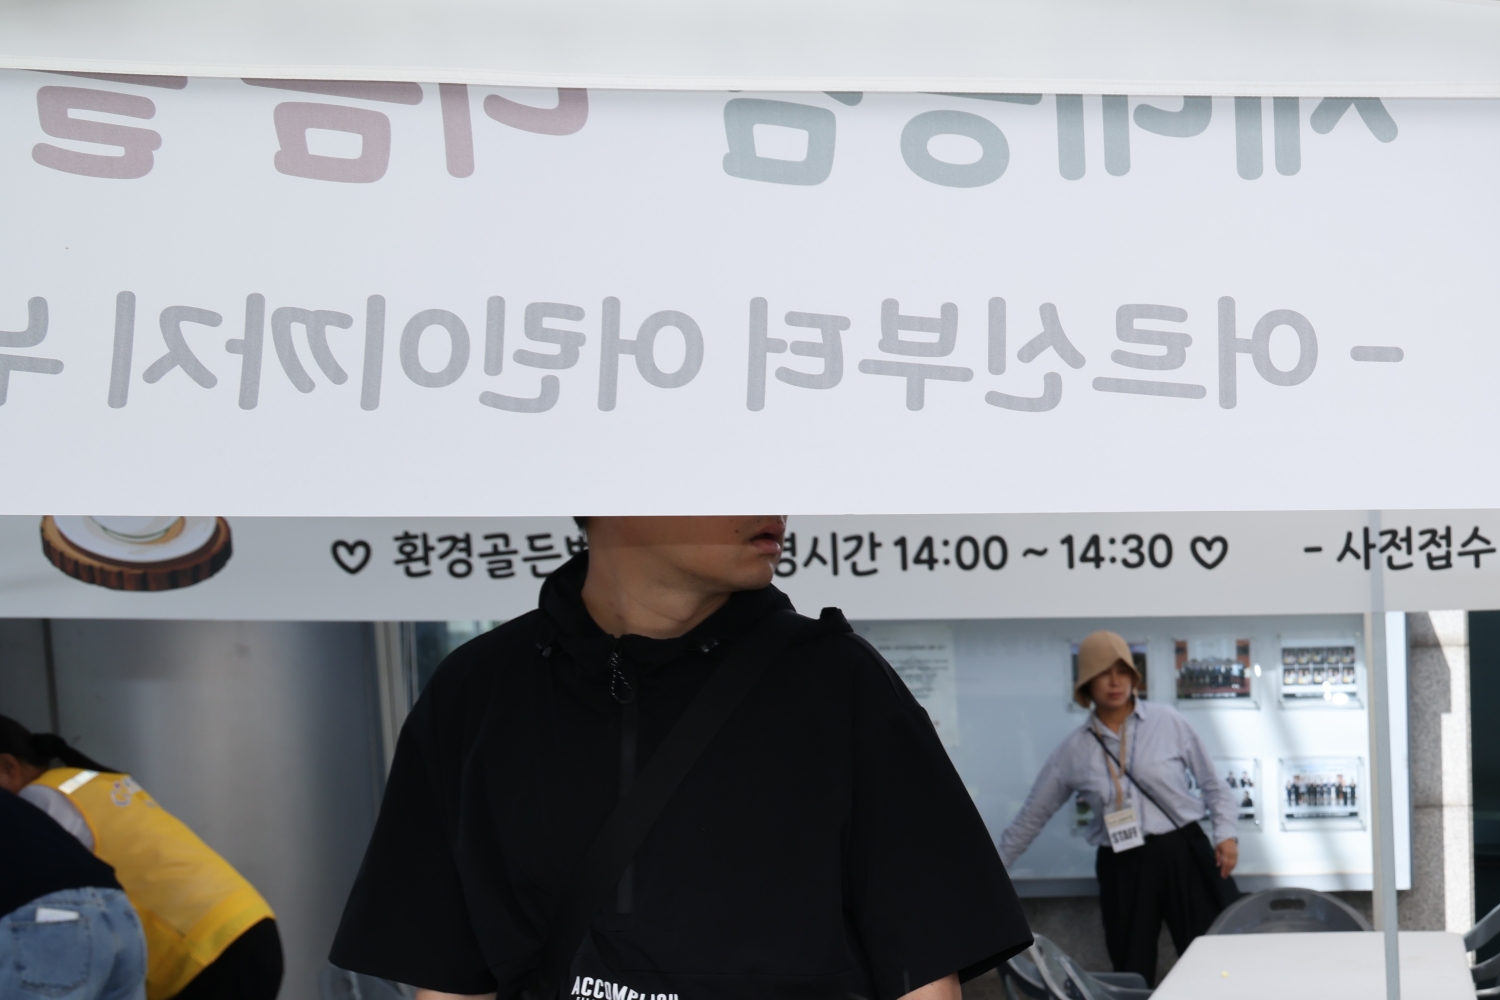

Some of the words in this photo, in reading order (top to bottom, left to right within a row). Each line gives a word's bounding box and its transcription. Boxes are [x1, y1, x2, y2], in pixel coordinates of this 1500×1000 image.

[893, 534, 1008, 571] 14:00
[1060, 533, 1173, 570] 14:30
[1335, 525, 1497, 571] 사전접수
[1111, 826, 1138, 844] STAFF
